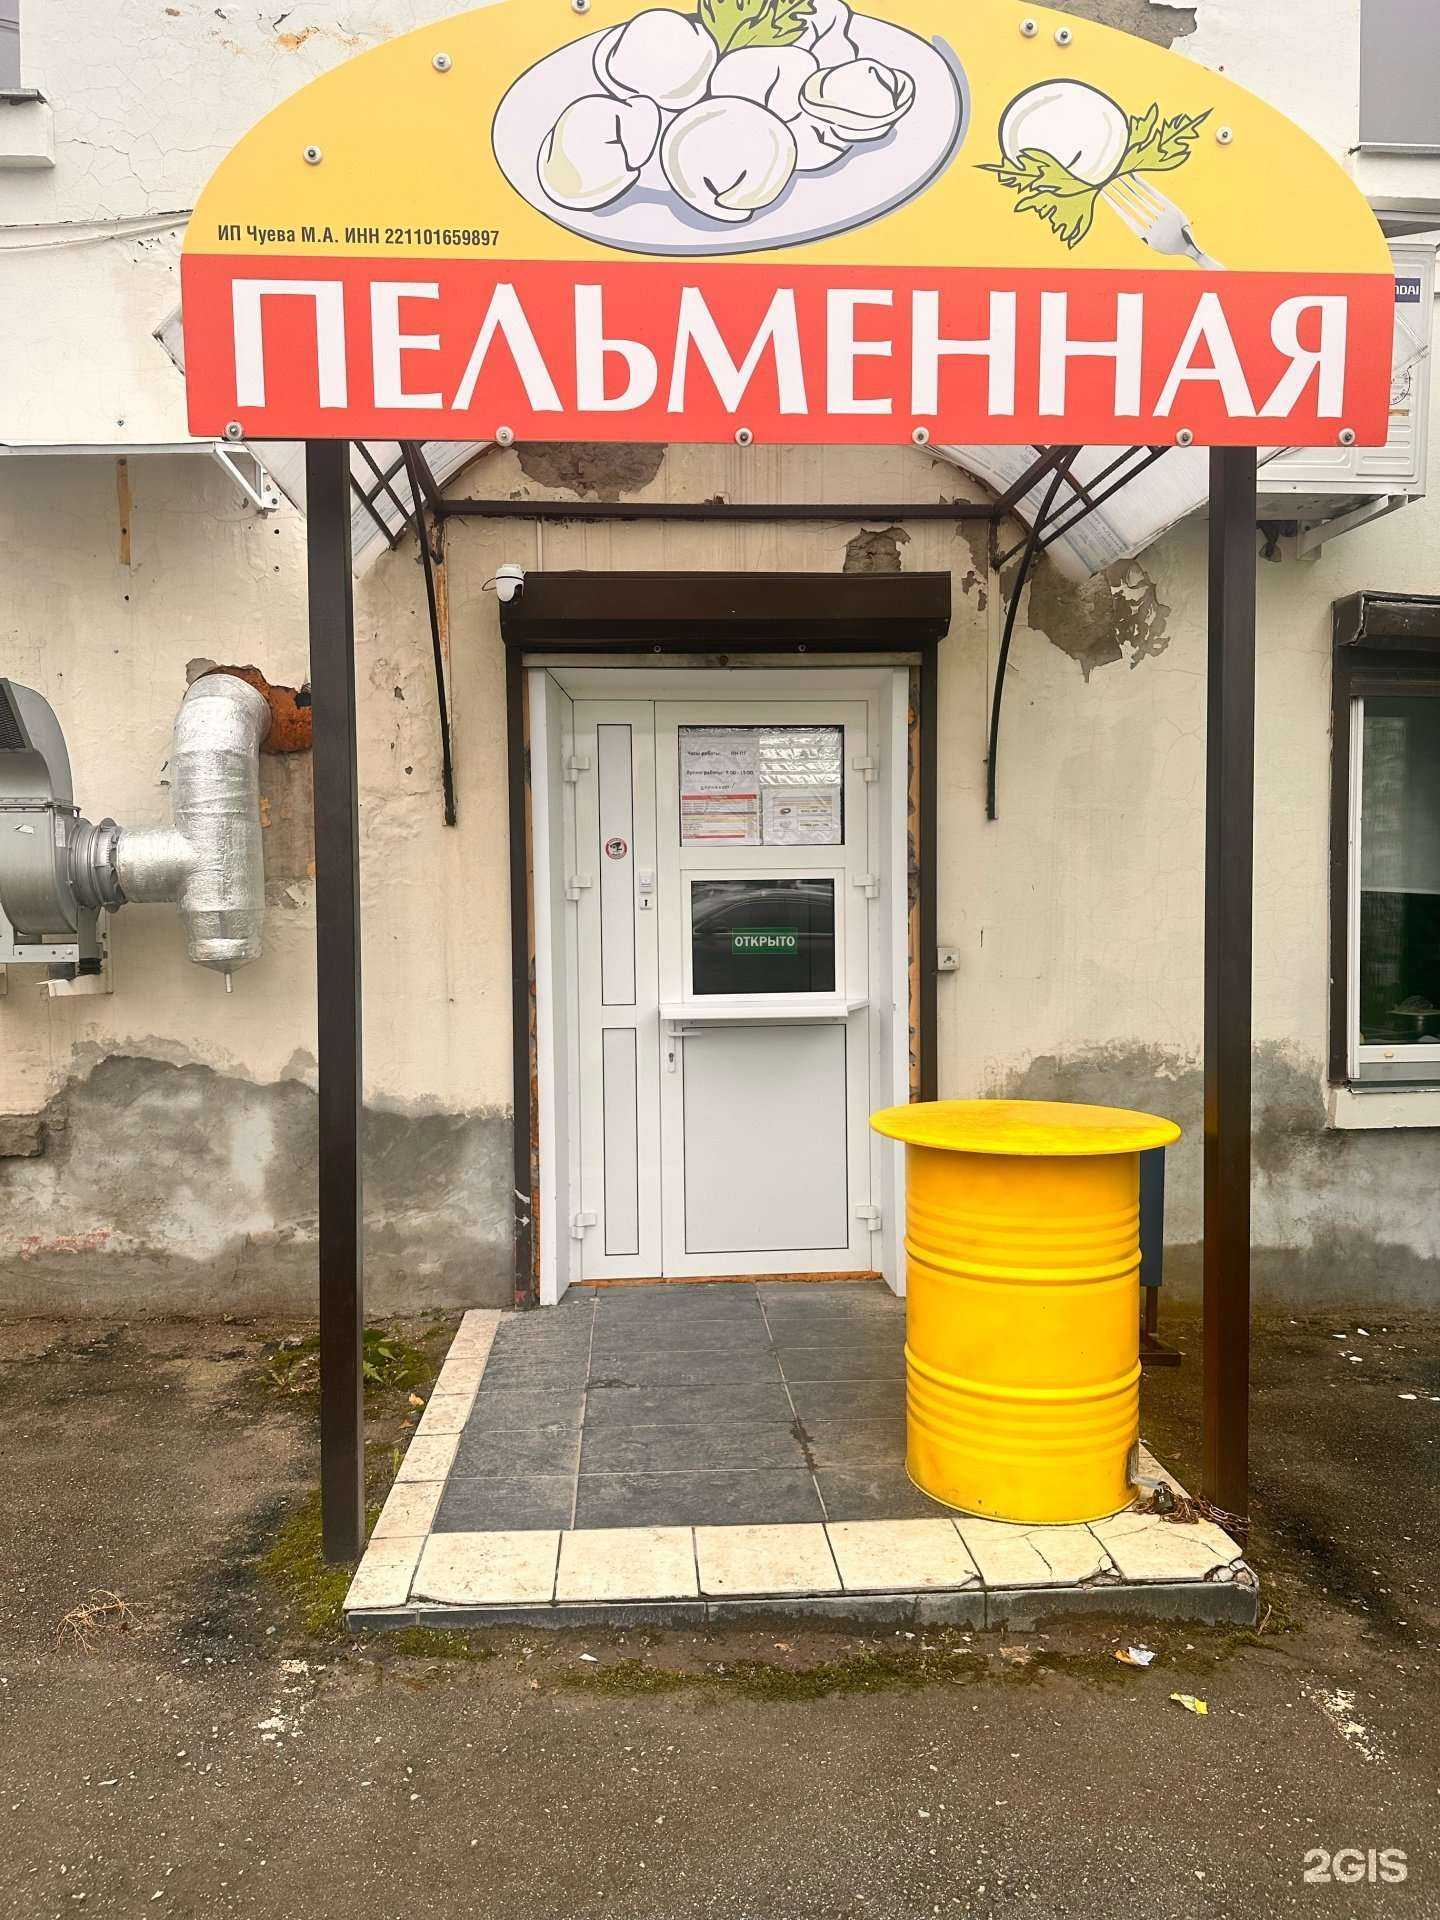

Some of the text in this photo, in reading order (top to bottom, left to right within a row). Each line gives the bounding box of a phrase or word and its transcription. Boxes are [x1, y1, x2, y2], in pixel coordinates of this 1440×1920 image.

[218, 225, 500, 246] ИП Чуева М.А. ИНН 221101659897
[231, 279, 1348, 418] ПЕЛЬМЕННАЯ
[734, 935, 796, 948] ОТКРЫТО
